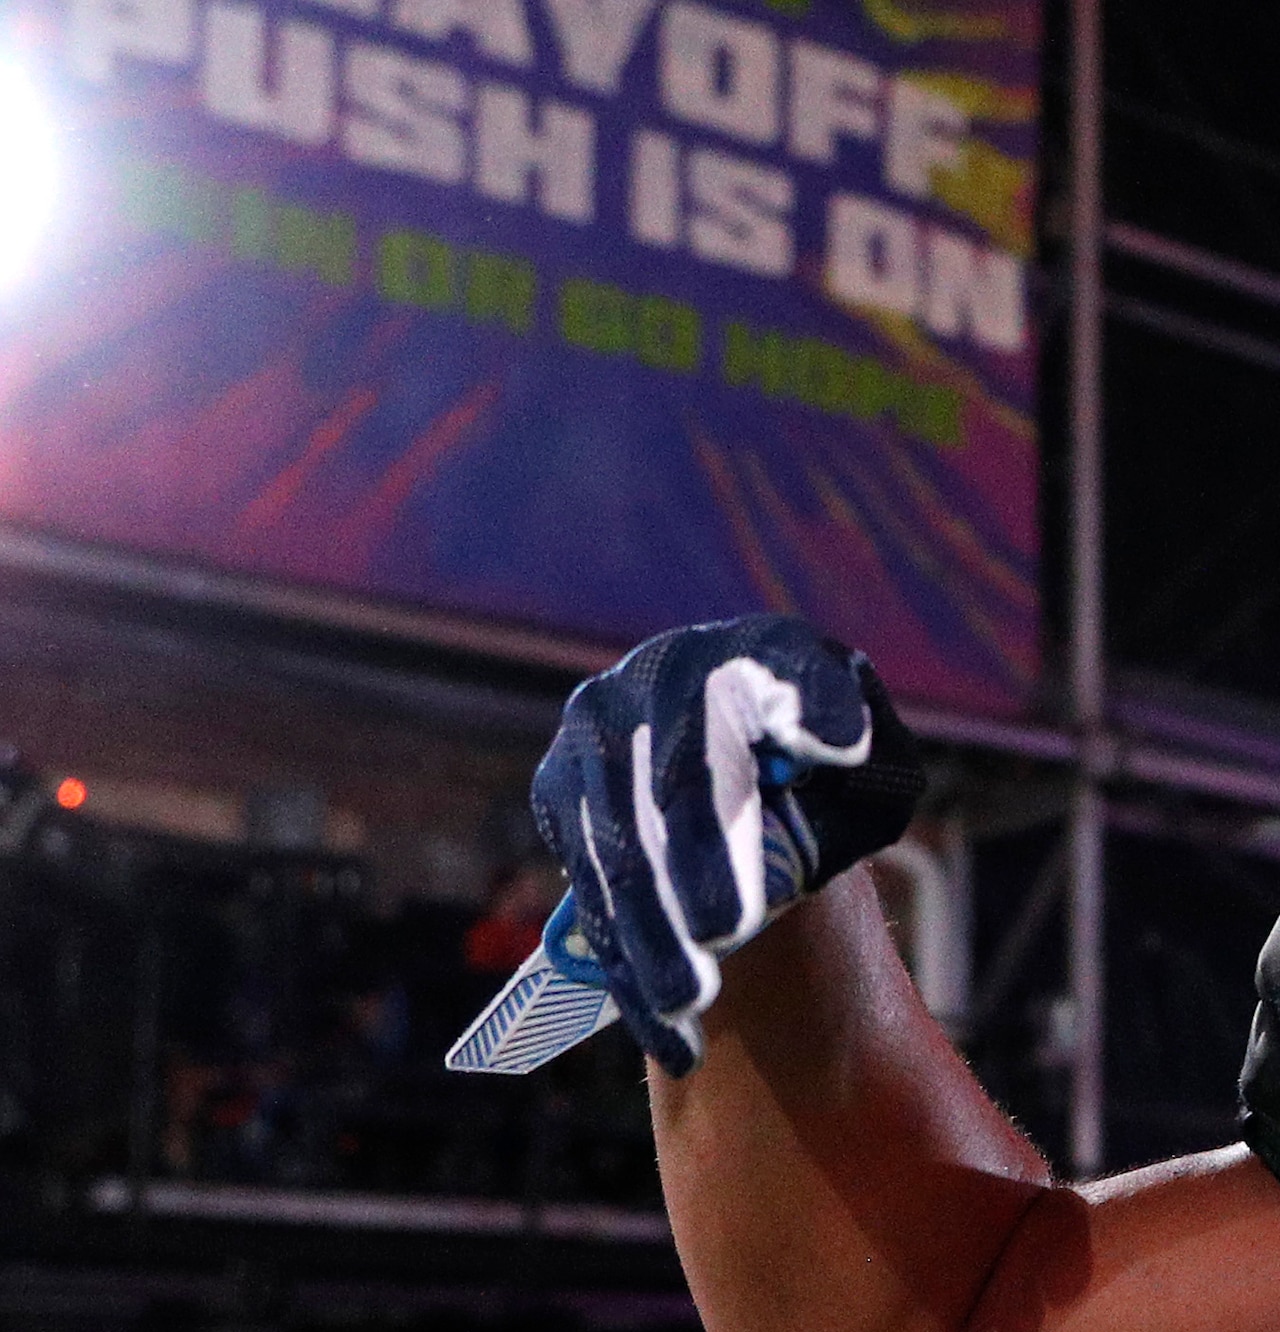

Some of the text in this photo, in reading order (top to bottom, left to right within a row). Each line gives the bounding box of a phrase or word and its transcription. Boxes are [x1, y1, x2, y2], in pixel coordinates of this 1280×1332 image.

[65, 0, 1024, 352] PUSH IS ON
[373, 225, 540, 338] OR
